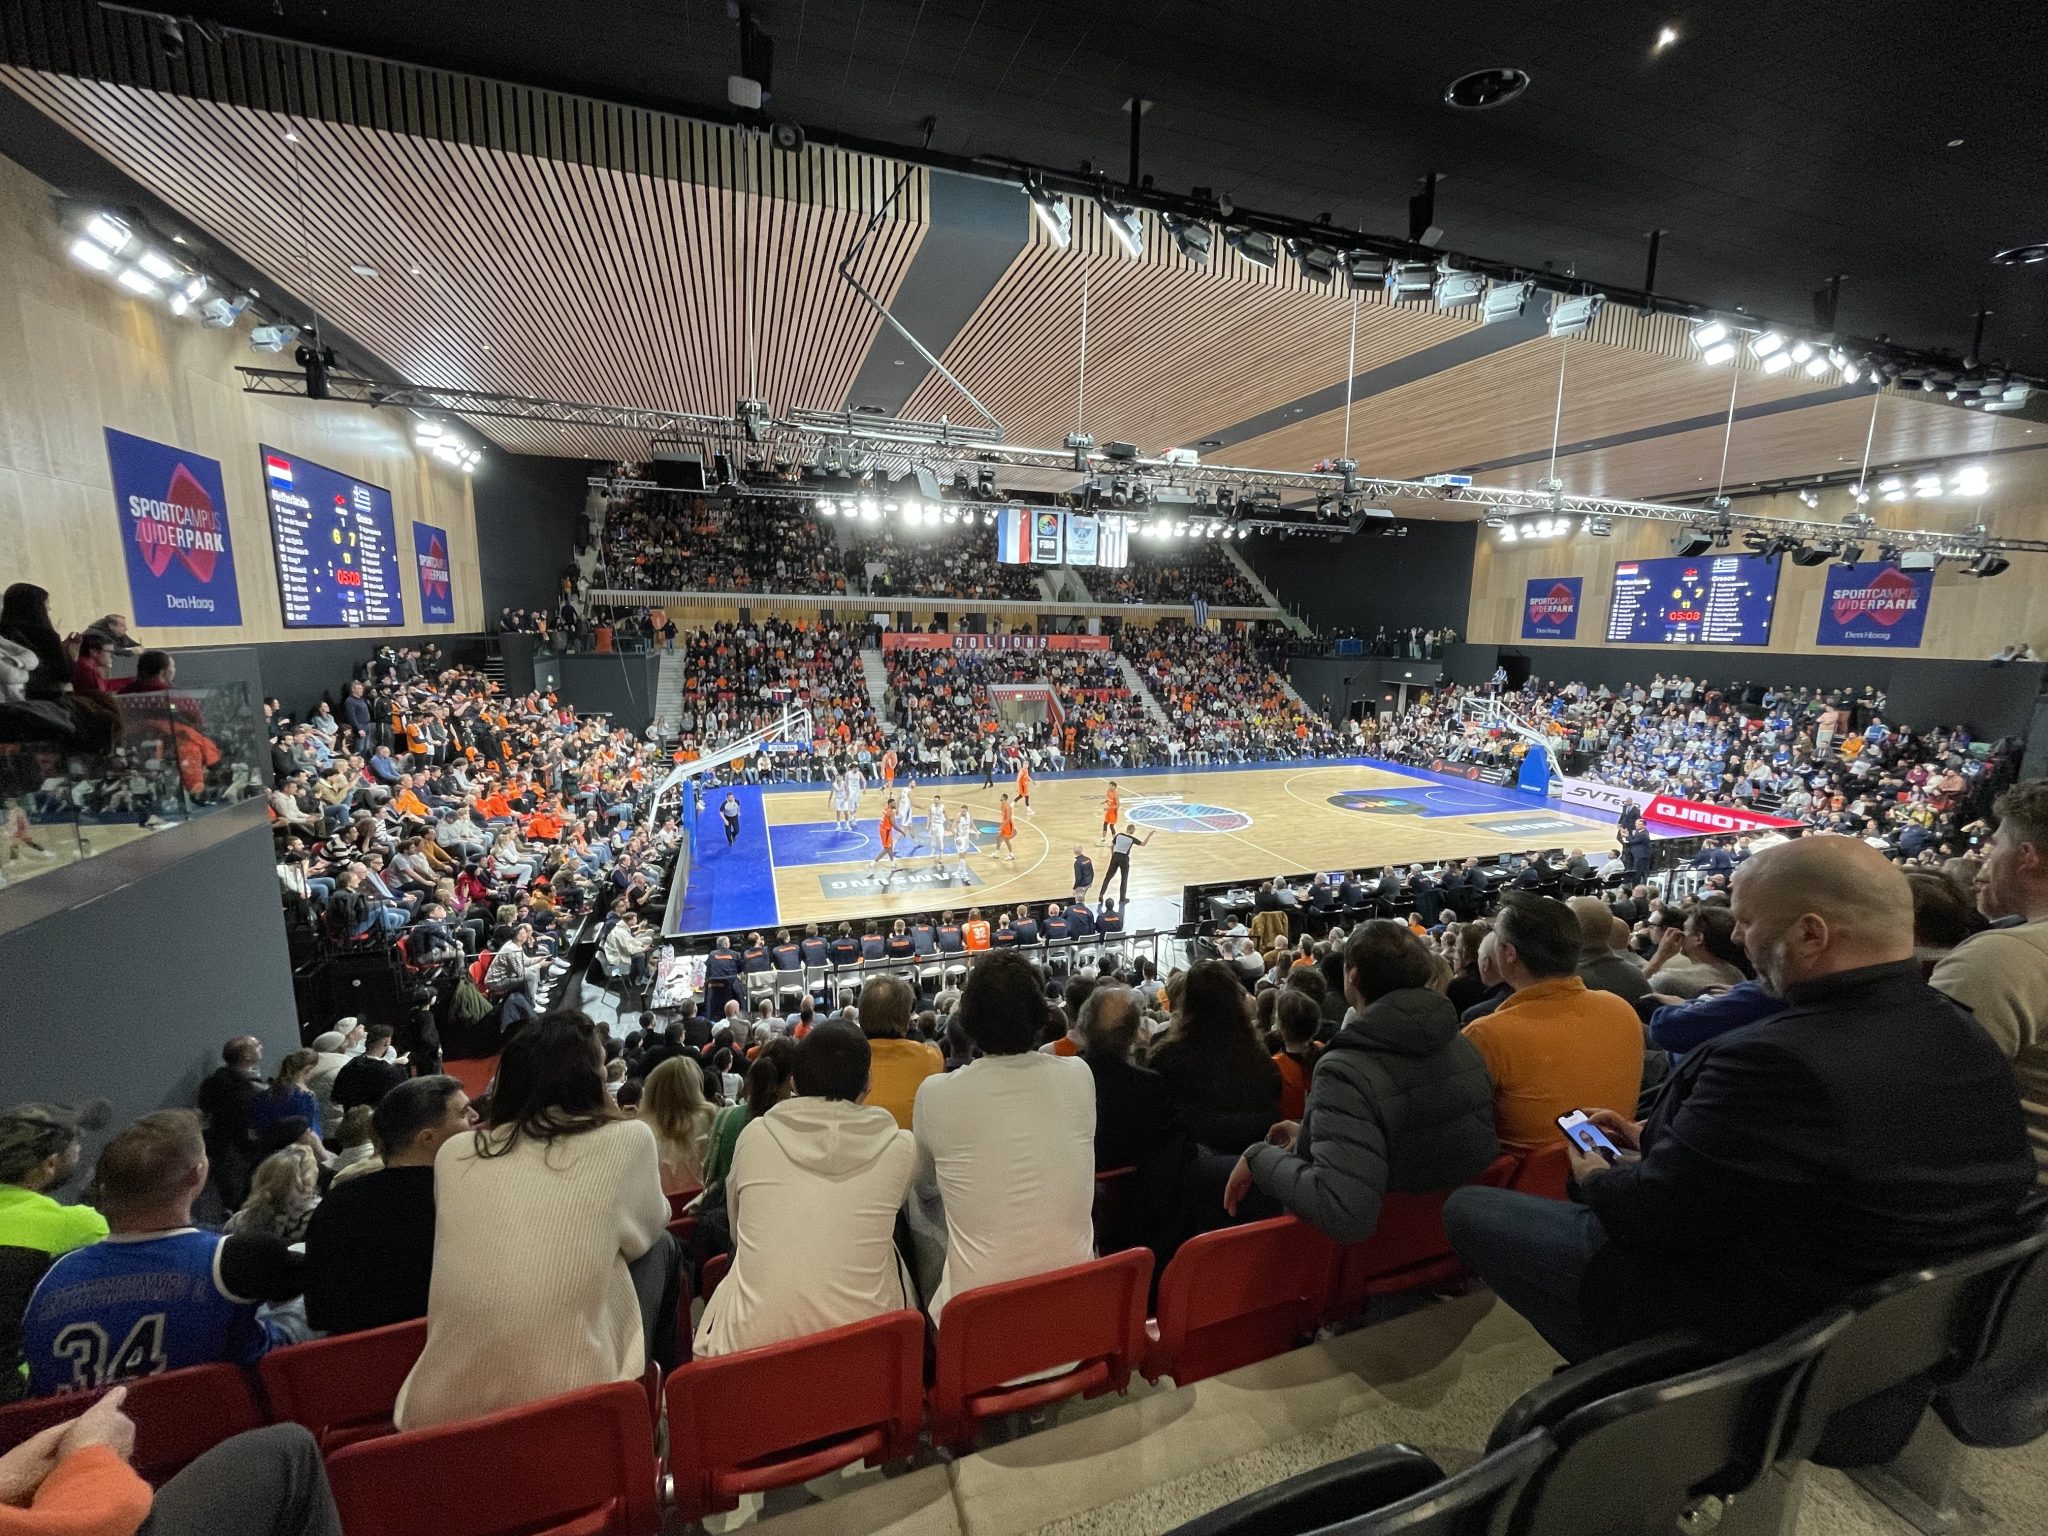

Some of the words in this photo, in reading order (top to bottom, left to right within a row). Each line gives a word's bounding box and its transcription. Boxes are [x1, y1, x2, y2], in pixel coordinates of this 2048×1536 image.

[129, 495, 222, 531] SPORTCAMPUS
[135, 519, 224, 552] ZUIDERPARK
[333, 528, 341, 545] 6
[348, 532, 356, 547] 7
[337, 569, 361, 586] 05:08
[1672, 588, 1682, 598] 6
[1694, 588, 1703, 598] 7
[1832, 587, 1920, 600] SPORTCAMPUS
[167, 594, 188, 609] Den
[189, 595, 214, 612] Haag
[341, 609, 348, 622] 3
[359, 610, 364, 622] 1
[1669, 612, 1700, 621] 05:08
[1665, 632, 1673, 642] 3
[1690, 633, 1696, 641] 1
[1845, 631, 1863, 639] Den
[1864, 632, 1891, 641] Haag
[955, 637, 977, 649] GO
[986, 637, 1048, 649] LIONS
[973, 926, 987, 940] 32
[53, 1313, 168, 1390] 34
